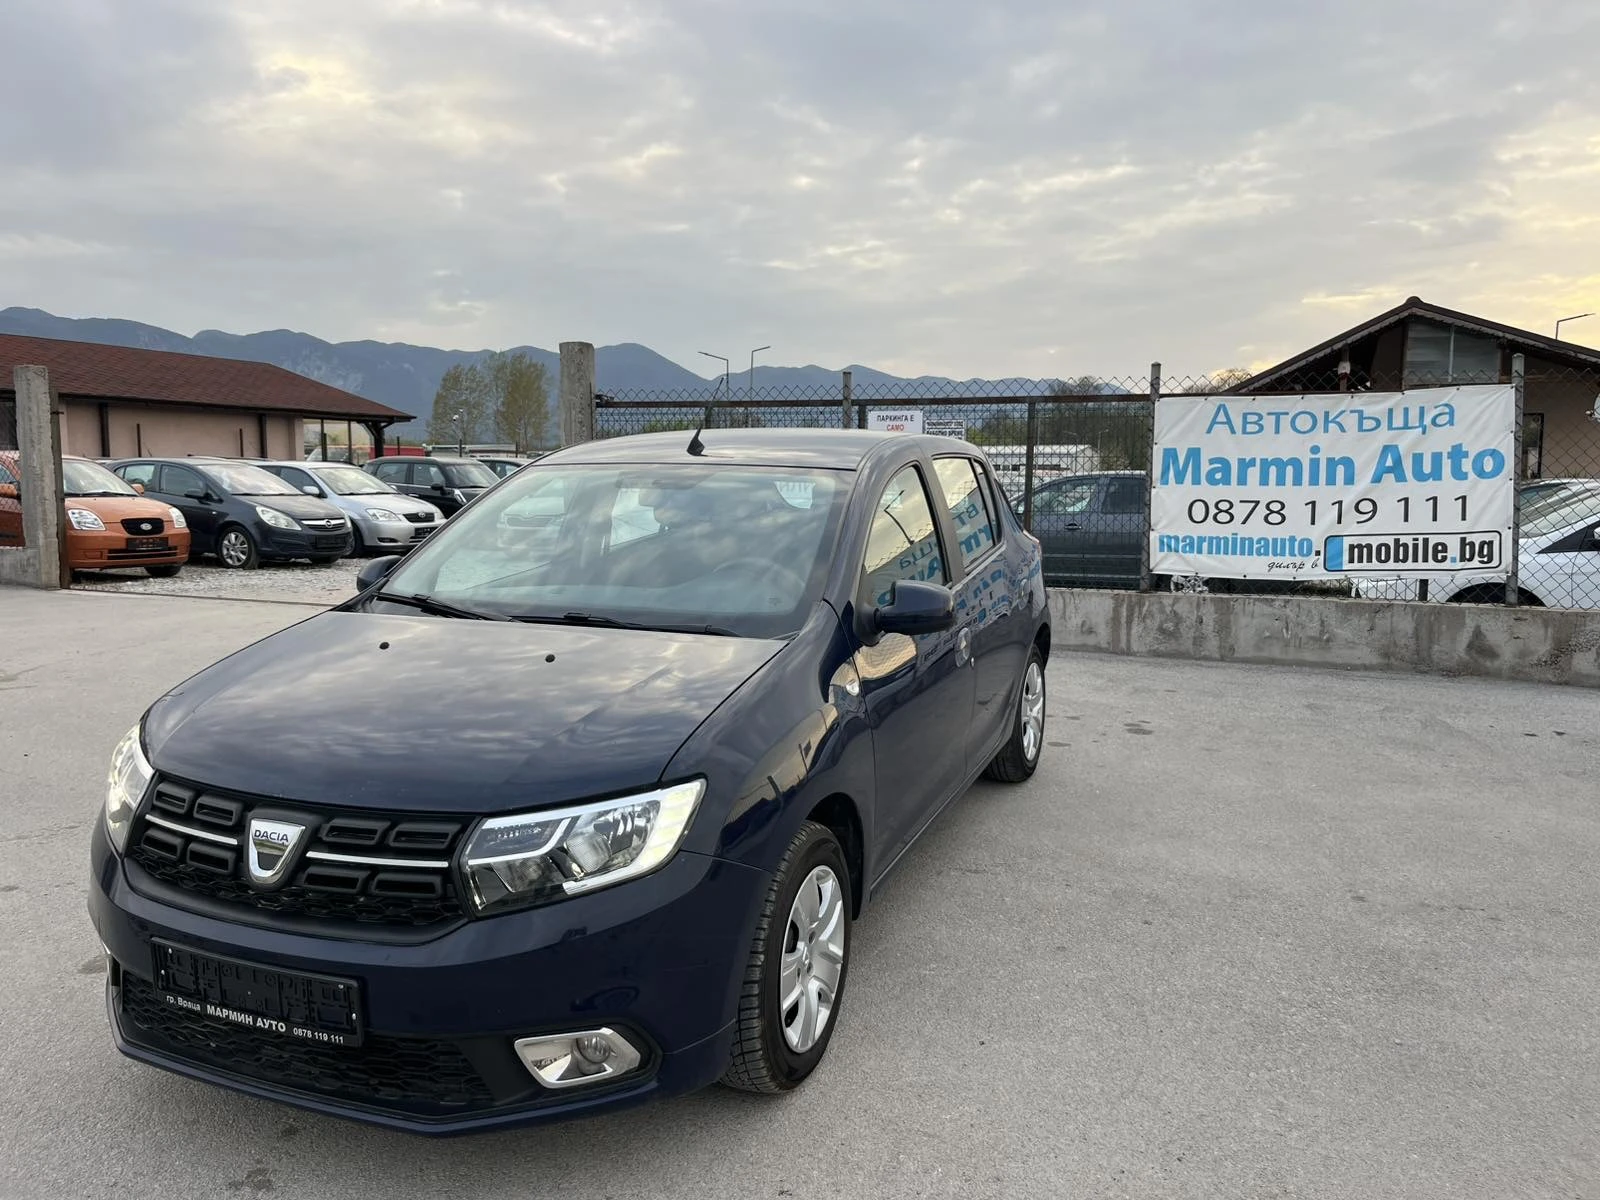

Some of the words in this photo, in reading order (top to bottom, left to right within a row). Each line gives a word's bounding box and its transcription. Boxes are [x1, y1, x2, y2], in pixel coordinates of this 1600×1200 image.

[877, 414, 909, 423] ПАРКИНГА
[886, 424, 905, 432] САМО
[1206, 402, 1456, 436] Автокъща
[1159, 445, 1356, 487] Marmin
[1370, 443, 1506, 484] Auto
[1187, 498, 1287, 526] 0878
[1304, 498, 1378, 526] 119
[1396, 495, 1468, 523] 111
[1347, 535, 1495, 565] mobile.bg
[1267, 560, 1306, 573] дилър
[254, 829, 289, 843] DACIA
[206, 1004, 254, 1026] МАРМИН
[256, 1017, 286, 1032] АУТО
[293, 1027, 312, 1038] 0878
[314, 1031, 328, 1041] 119
[330, 1034, 344, 1044] 111
